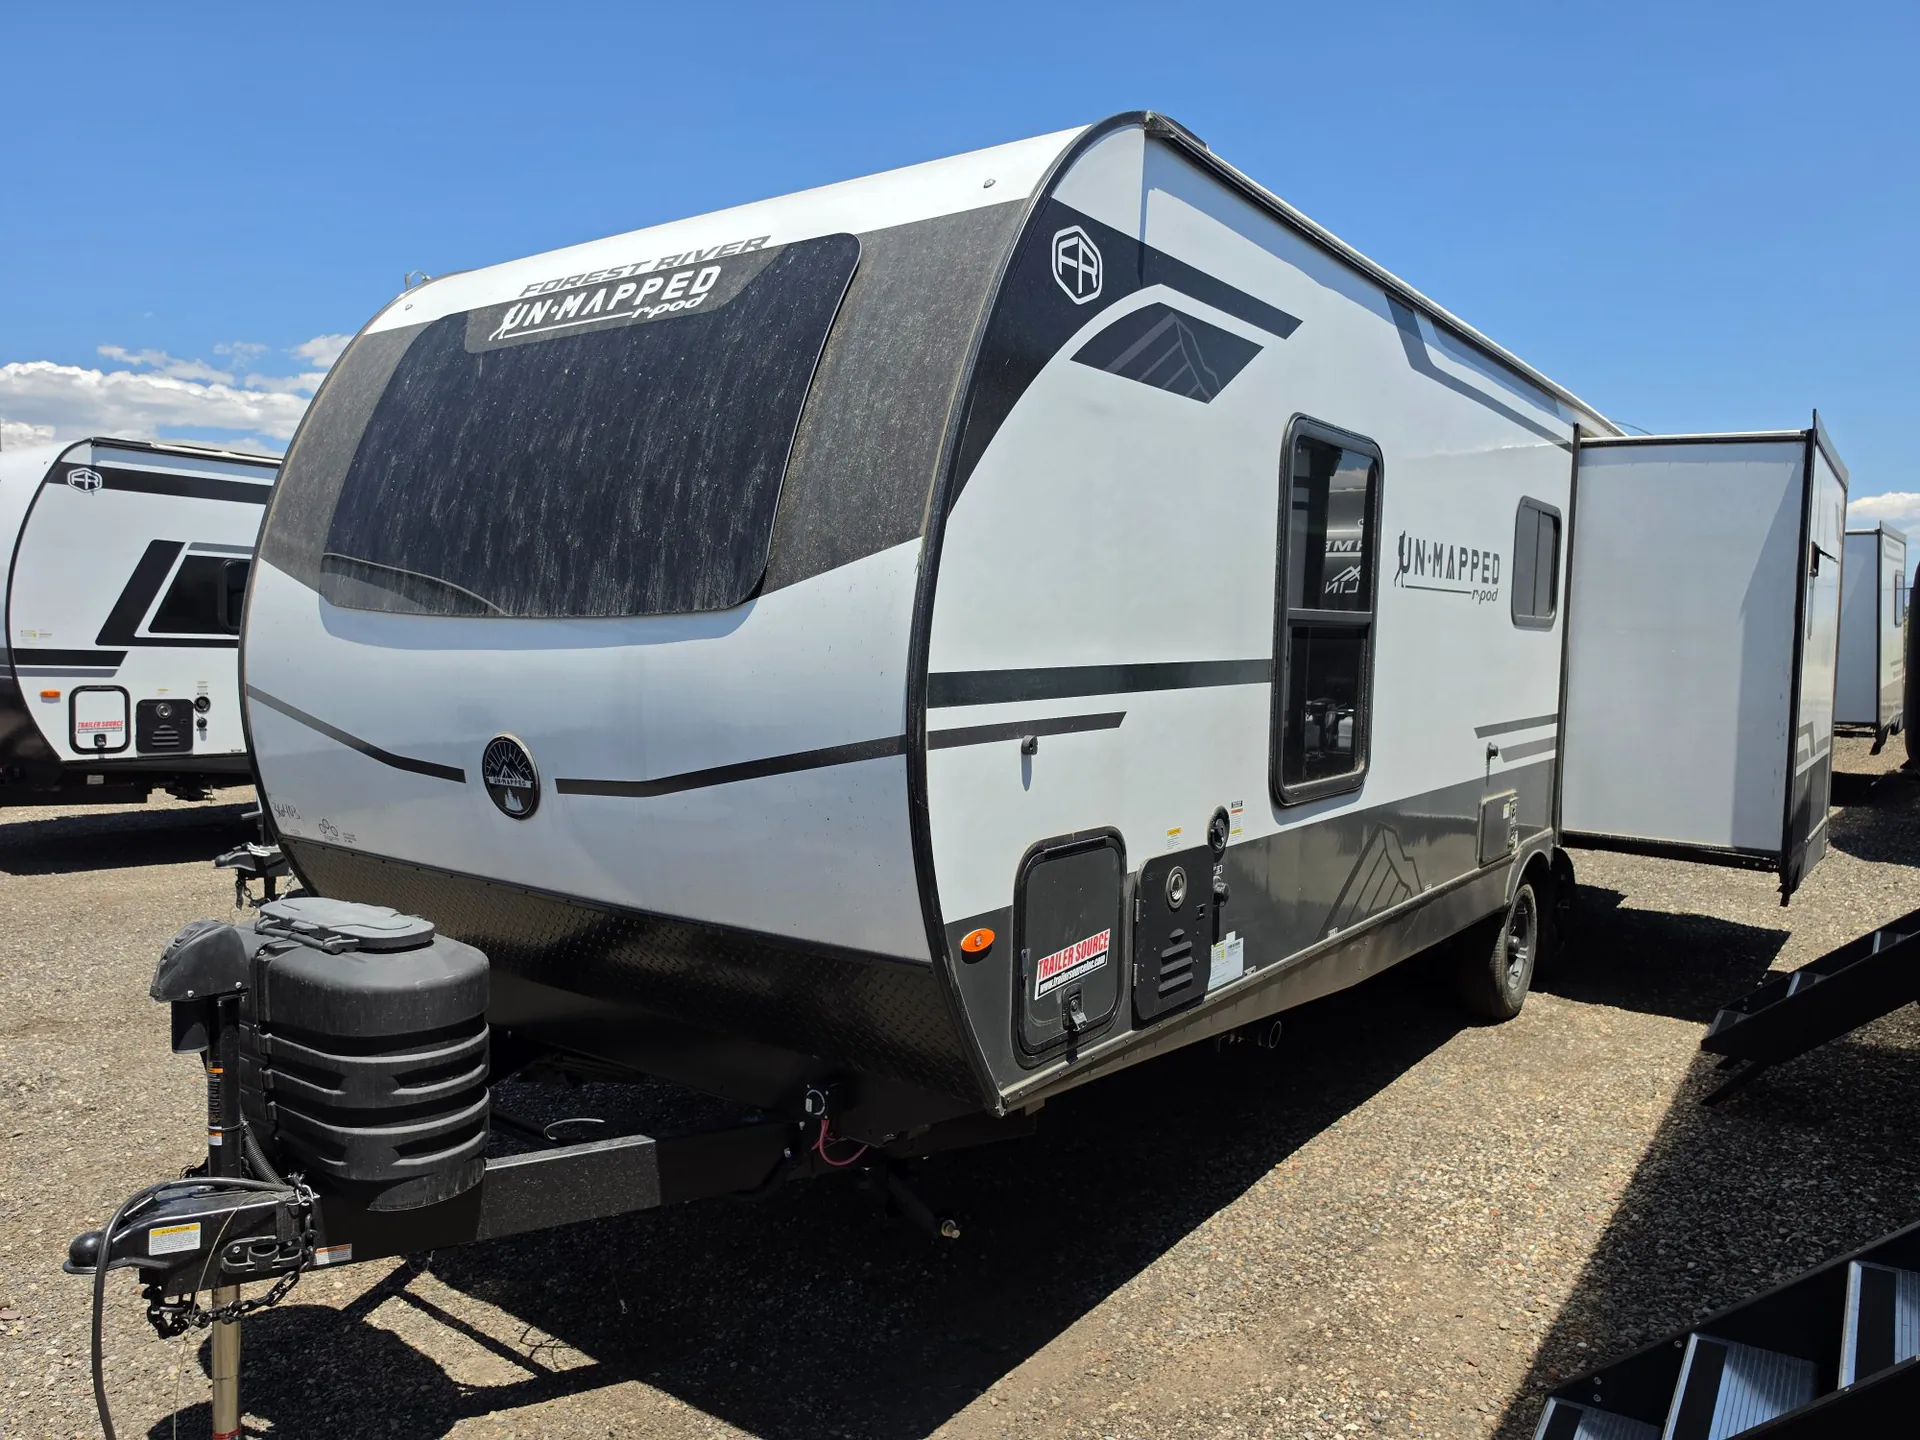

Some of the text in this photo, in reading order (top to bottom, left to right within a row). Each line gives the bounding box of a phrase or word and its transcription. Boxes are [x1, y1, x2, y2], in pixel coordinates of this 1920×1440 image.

[518, 235, 772, 298] FOREST RIVER
[1039, 931, 1109, 980] TRAILER SOURCE
